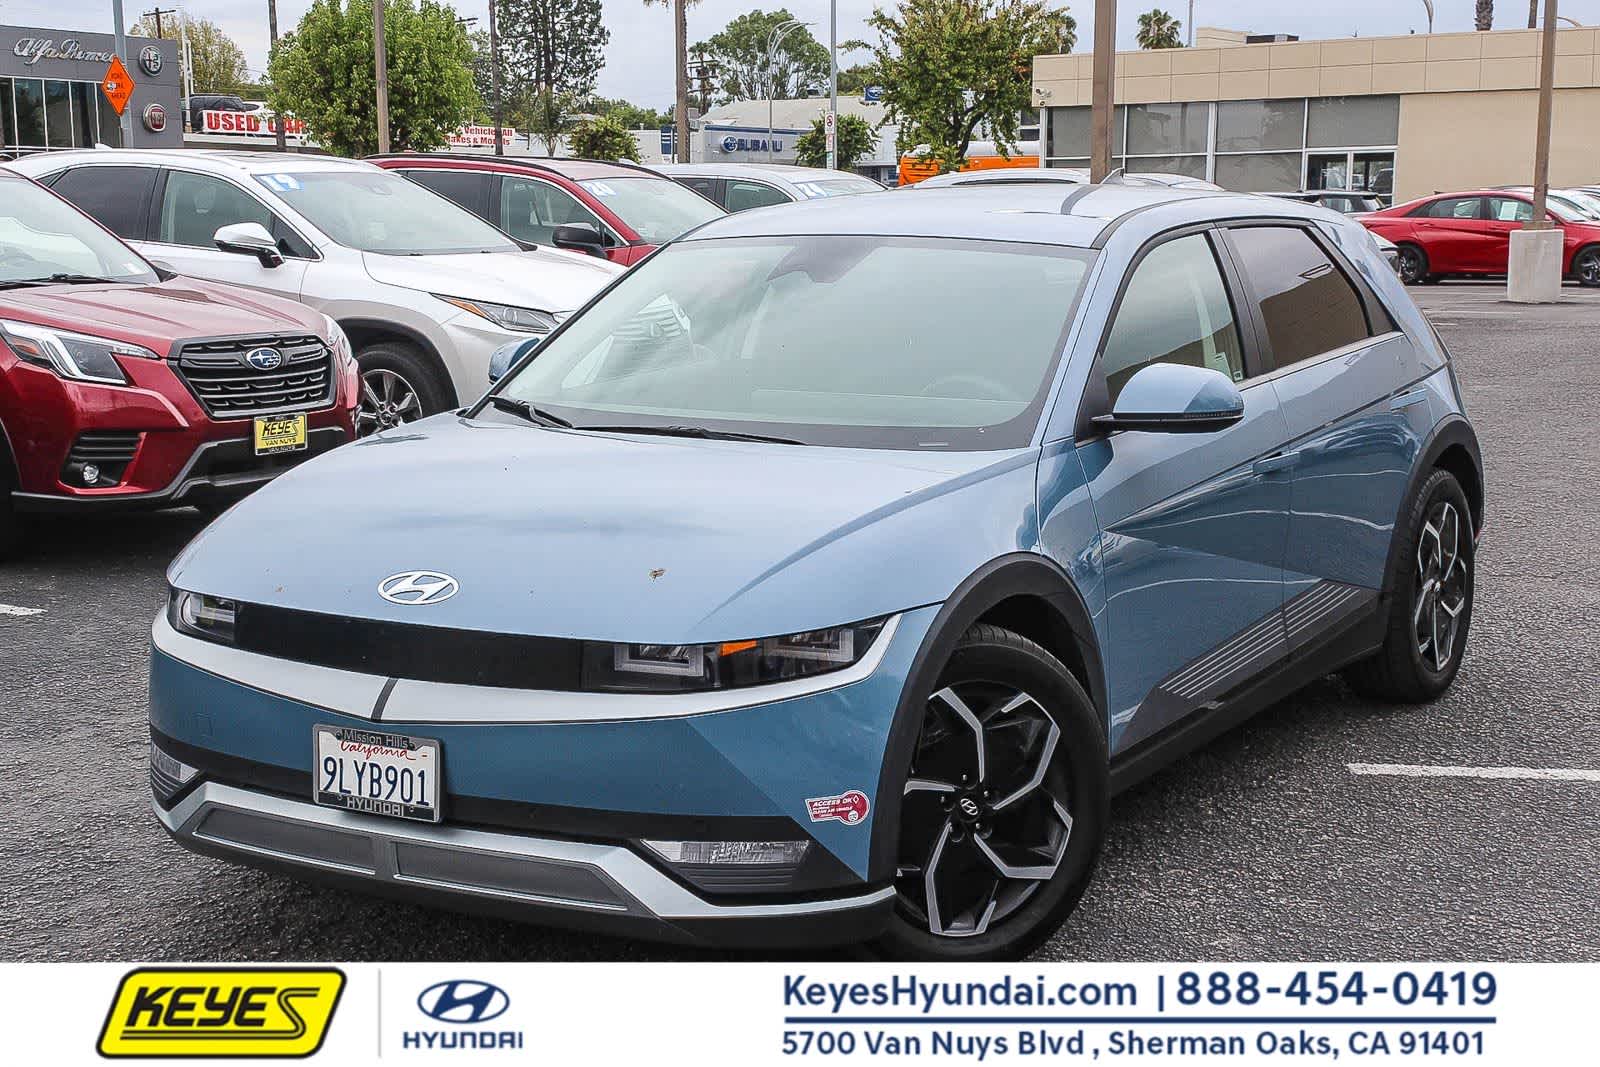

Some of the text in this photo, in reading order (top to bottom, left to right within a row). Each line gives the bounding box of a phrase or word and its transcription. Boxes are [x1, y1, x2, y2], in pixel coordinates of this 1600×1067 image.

[14, 38, 61, 65] Alfa
[207, 112, 260, 132] USED
[464, 127, 513, 137] Vehicle All
[480, 136, 510, 145] Modls
[262, 420, 300, 438] KEYES
[343, 730, 408, 749] Mission Hills
[340, 740, 417, 761] California
[323, 756, 430, 807] 9LYB901
[346, 796, 405, 817] HYUNDAI
[812, 799, 841, 807] ACCESS
